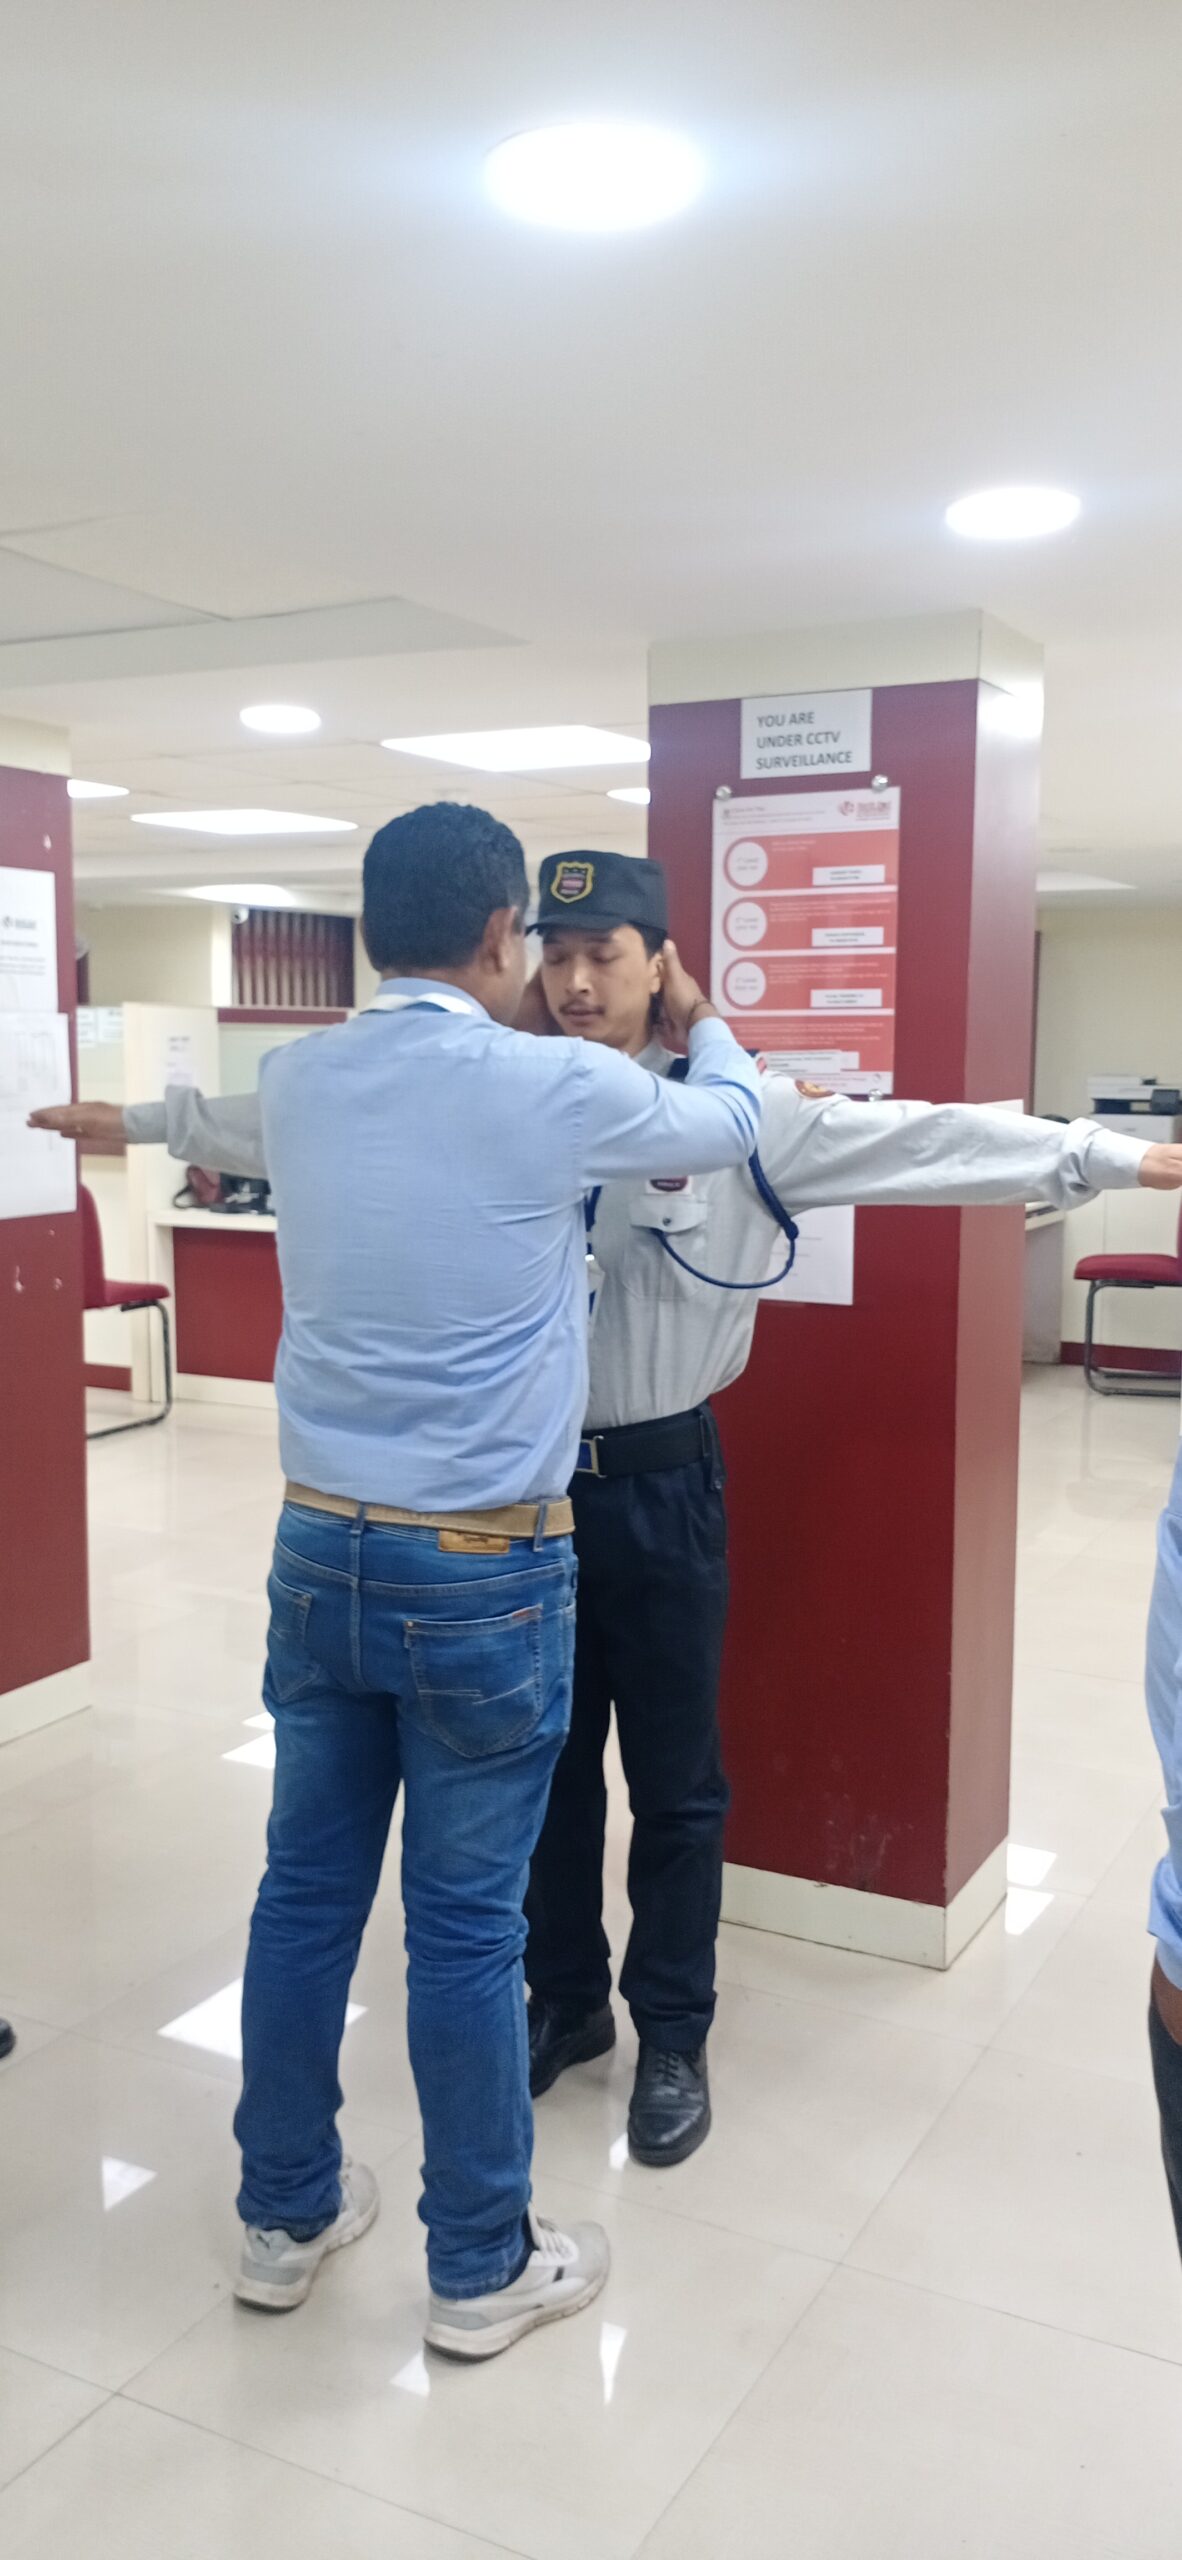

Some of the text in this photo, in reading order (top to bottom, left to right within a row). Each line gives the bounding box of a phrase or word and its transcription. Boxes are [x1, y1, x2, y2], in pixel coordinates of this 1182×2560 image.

[756, 711, 815, 728] YOU ARE
[756, 730, 841, 749] UNDER CCTV
[756, 750, 853, 770] SURVEILLANCE
